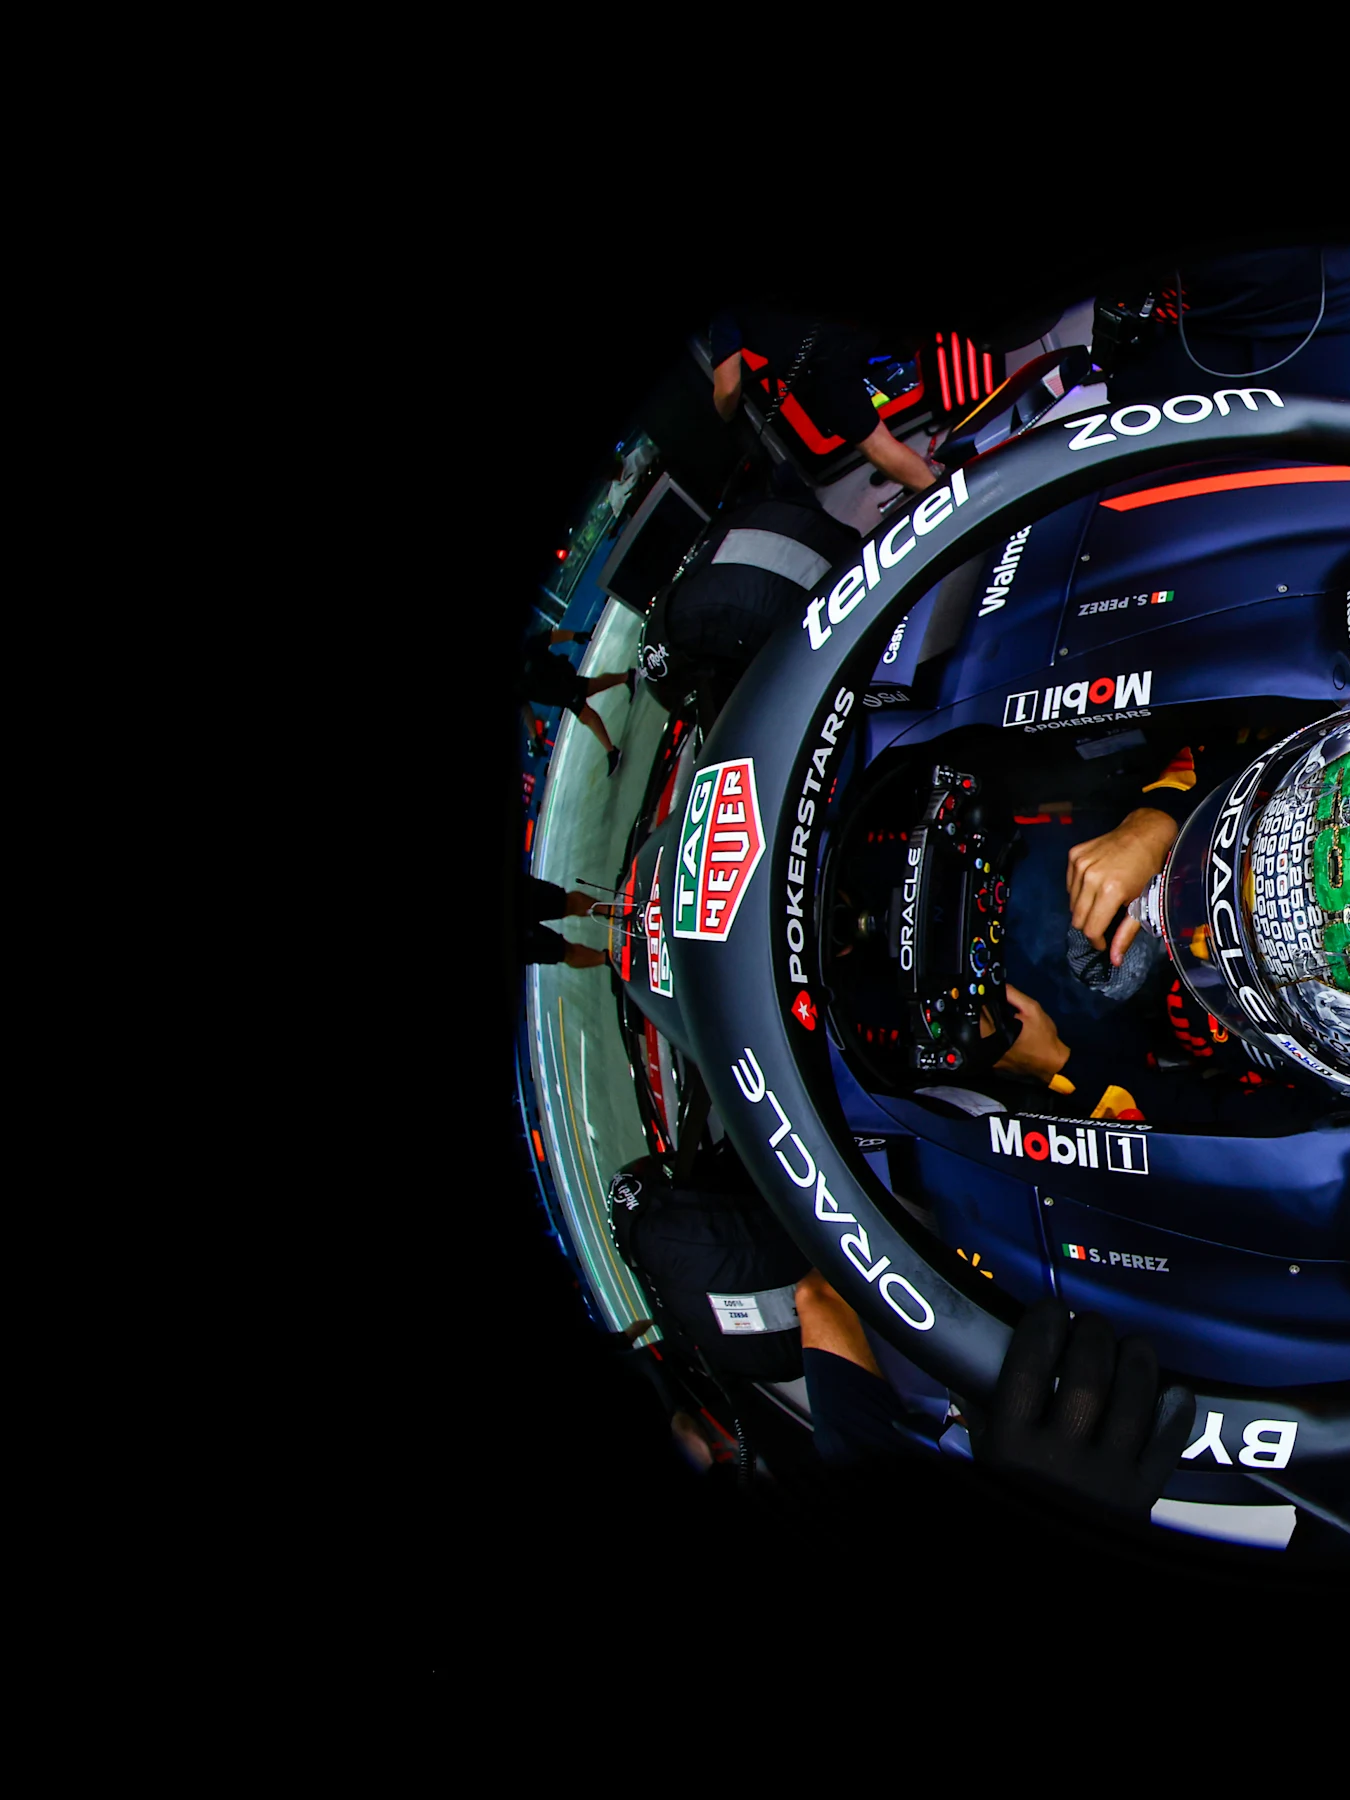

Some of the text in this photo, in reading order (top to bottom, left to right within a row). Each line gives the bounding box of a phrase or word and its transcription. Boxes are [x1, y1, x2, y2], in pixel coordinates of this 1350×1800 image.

[1064, 388, 1285, 452] zoom
[802, 468, 969, 651] telcel
[1078, 597, 1129, 617] PEREZ
[1036, 708, 1153, 732] POKERSTARS
[1041, 671, 1151, 722] Mobil
[677, 780, 713, 923] TAG
[705, 770, 750, 928] HEUER
[786, 687, 855, 983] POKERSTARS
[1206, 761, 1277, 1024] ORACLE
[901, 847, 921, 971] ORACLE
[731, 1047, 937, 1332] ORACLE
[990, 1116, 1099, 1169] Mobil
[1089, 1248, 1170, 1272] S. PEREZ
